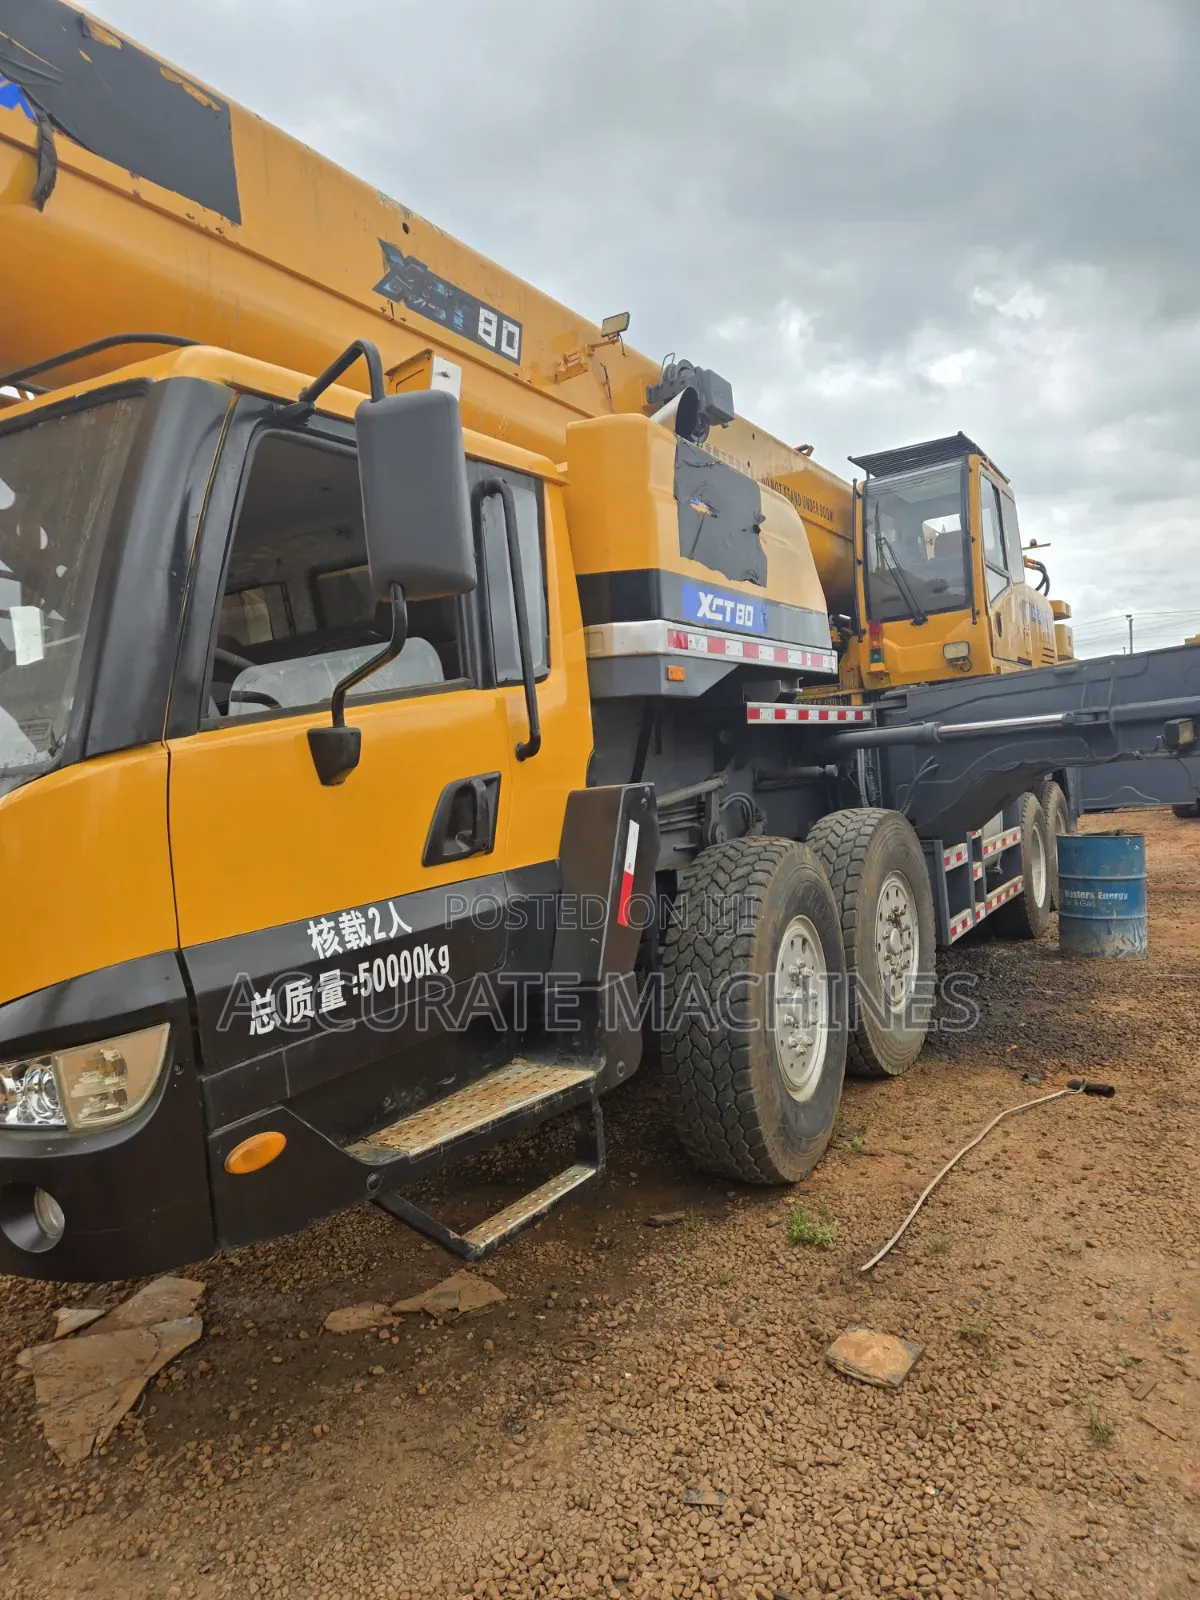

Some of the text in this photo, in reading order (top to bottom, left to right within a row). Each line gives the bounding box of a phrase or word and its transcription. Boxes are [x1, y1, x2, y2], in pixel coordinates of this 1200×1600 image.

[478, 305, 520, 360] 80
[771, 478, 782, 496] NOT
[784, 485, 802, 507] STAND
[802, 495, 820, 515] UNDER
[1098, 891, 1129, 901] Energy
[307, 901, 413, 960] 核载2人
